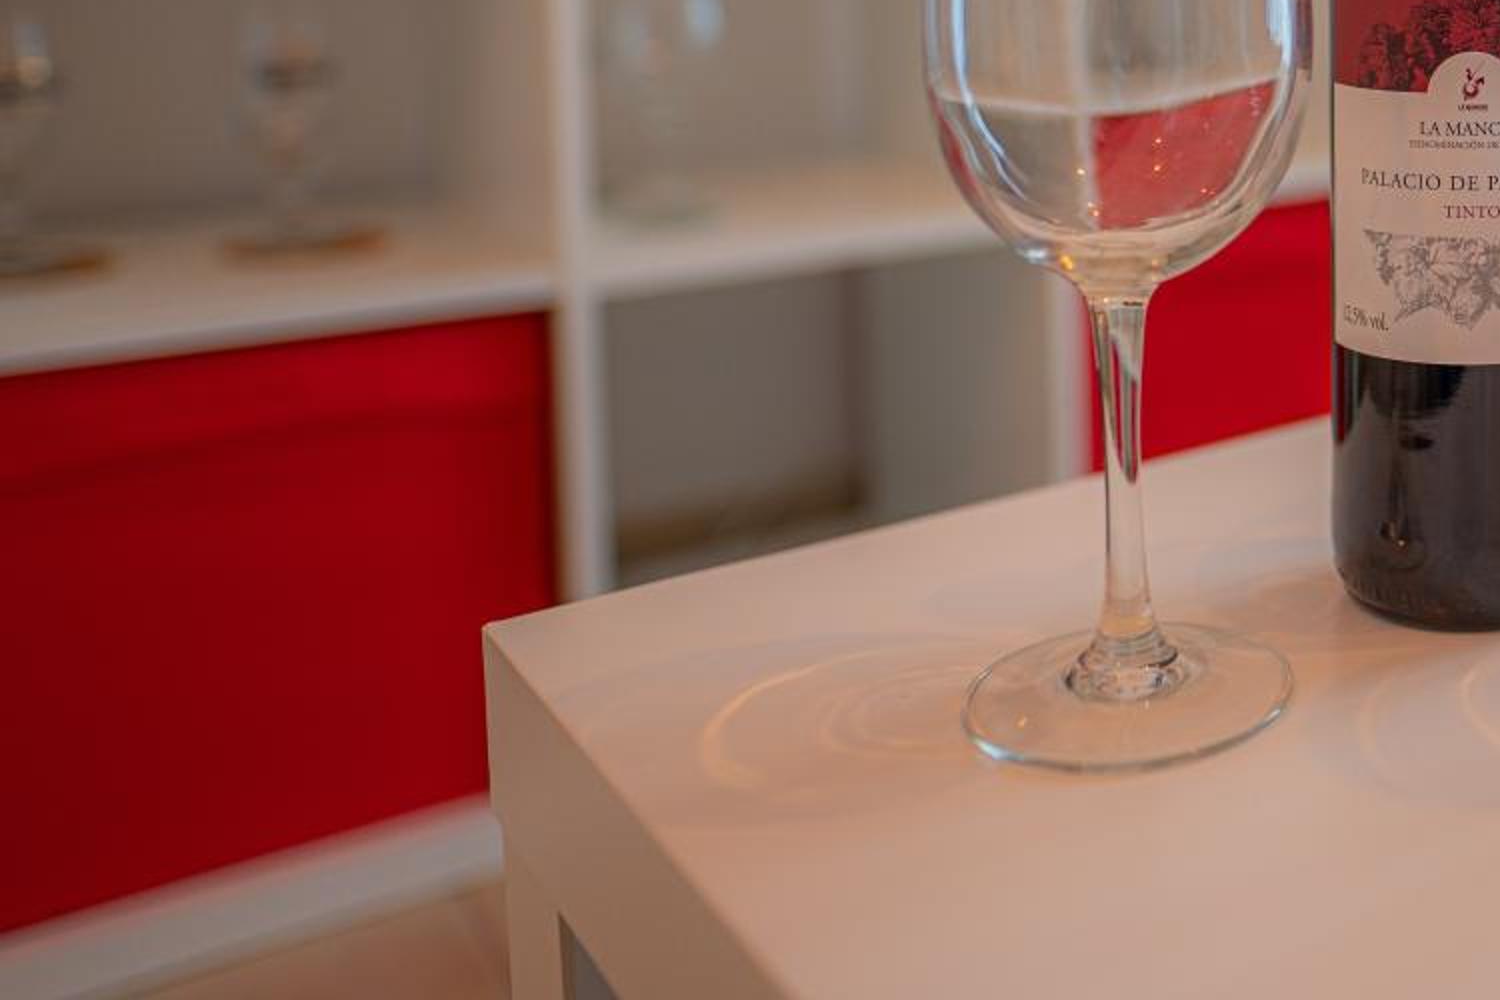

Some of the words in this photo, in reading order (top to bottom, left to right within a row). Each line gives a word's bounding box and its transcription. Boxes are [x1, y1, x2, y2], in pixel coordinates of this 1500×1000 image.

[1419, 121, 1441, 136] LA
[1361, 167, 1442, 191] PALACIO
[1450, 174, 1480, 191] DE
